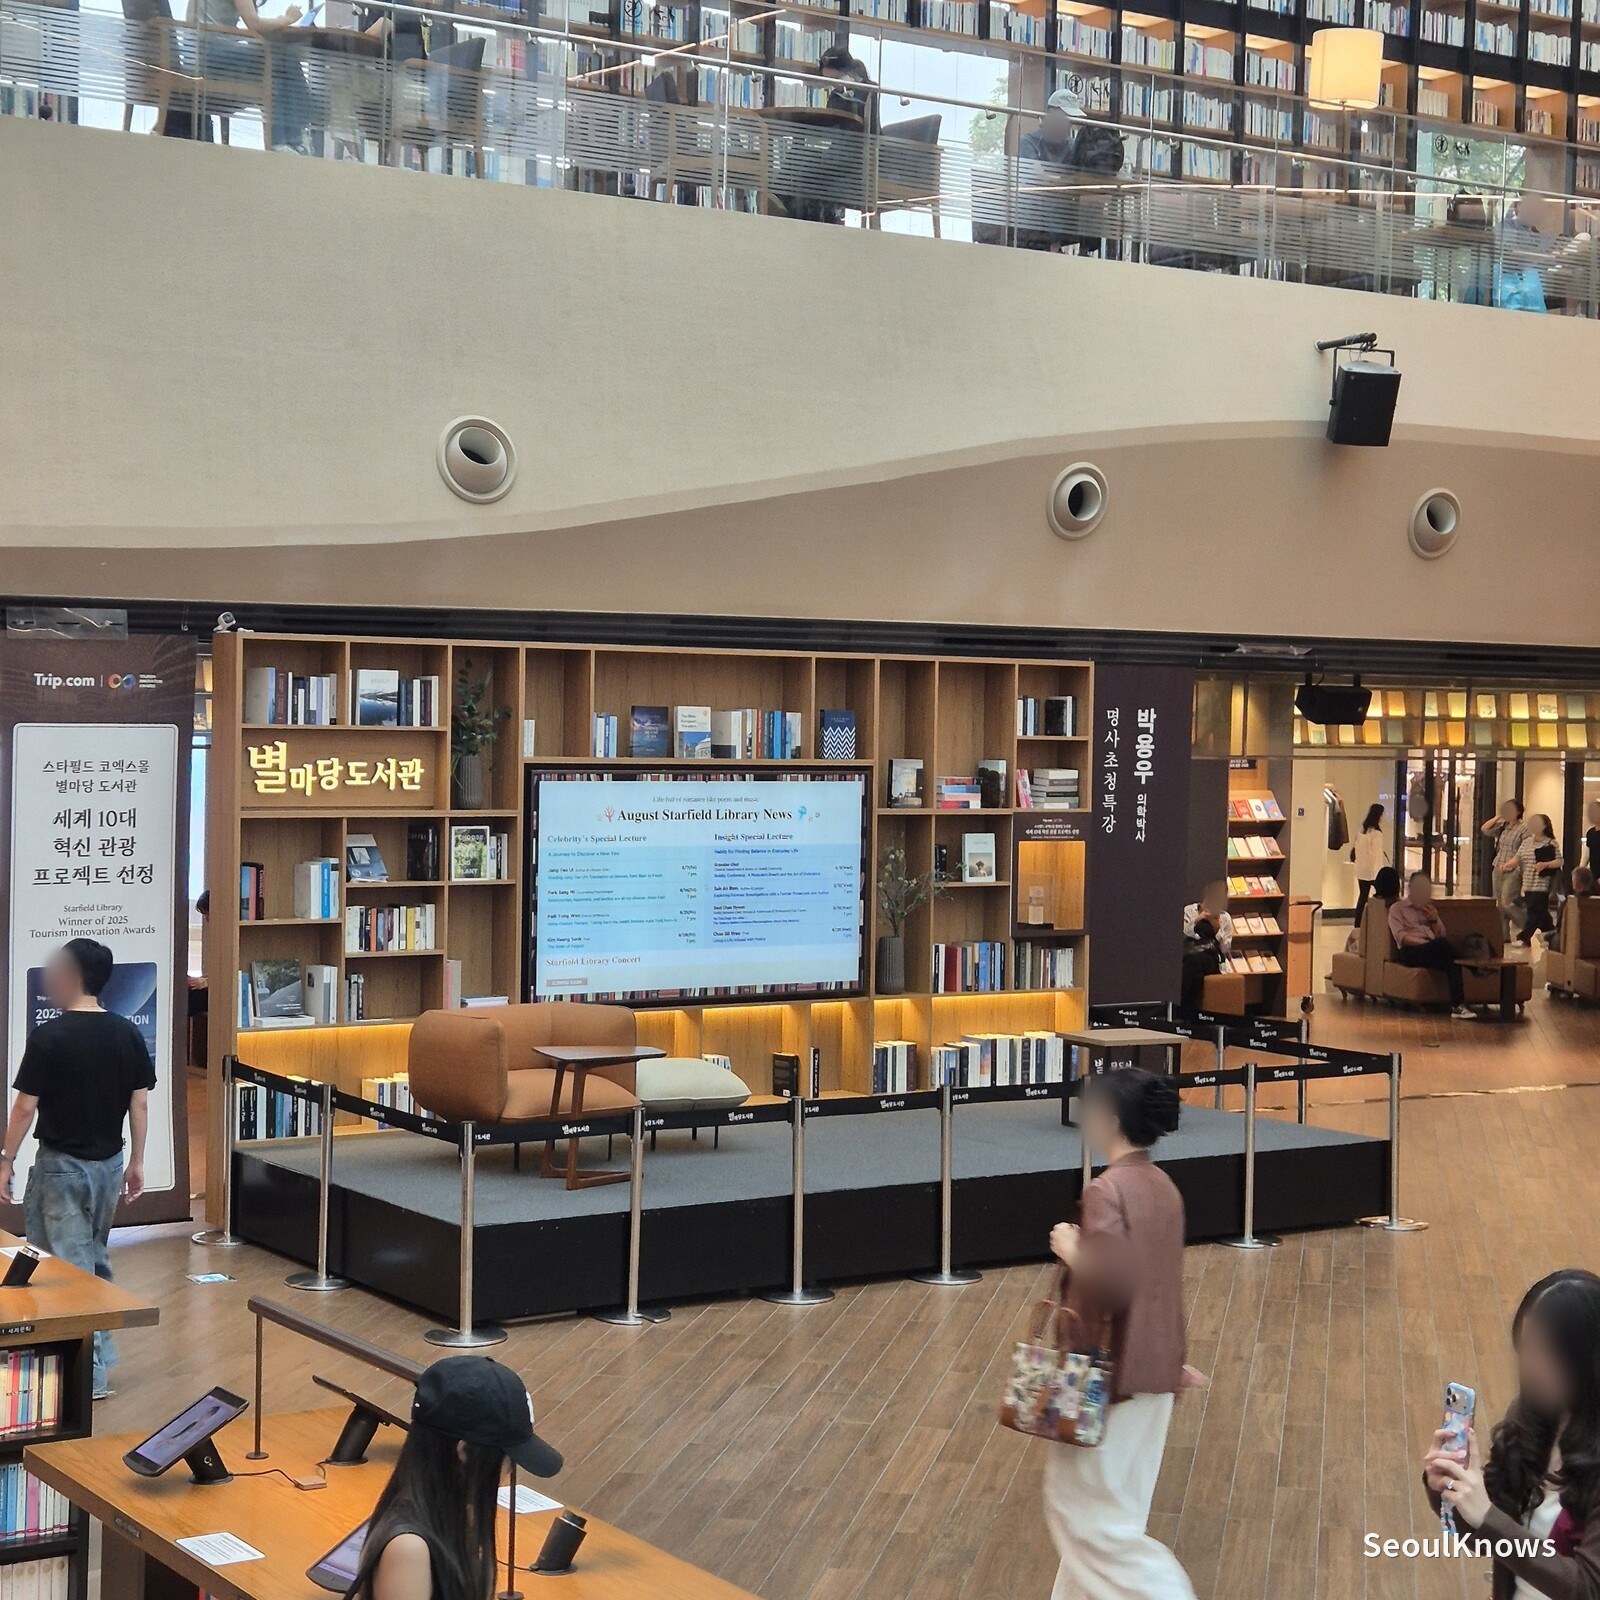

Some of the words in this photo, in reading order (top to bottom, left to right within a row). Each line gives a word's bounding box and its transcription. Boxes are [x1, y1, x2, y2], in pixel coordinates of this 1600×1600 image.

[33, 672, 95, 690] Trip.com
[1133, 707, 1157, 785] 박용우
[42, 759, 96, 774] 스타필드
[99, 759, 150, 774] 코엑스몰
[55, 778, 95, 794] 별마당
[98, 778, 138, 793] 도서관
[52, 808, 92, 829] 세계
[98, 807, 138, 829] 10대
[618, 809, 659, 824] August
[662, 809, 712, 821] Starfield
[715, 809, 760, 823] Library
[763, 808, 793, 820] News
[547, 835, 589, 844] Celebrity's
[590, 834, 617, 844] Special
[619, 834, 647, 842] Lecture
[714, 833, 739, 842] Insight
[740, 833, 765, 842] Special
[53, 837, 92, 858] 혁신
[98, 836, 138, 857] 관광
[32, 866, 111, 886] 프로젝트
[117, 864, 155, 884] 선정
[63, 904, 95, 912] Starfield
[96, 903, 123, 914] Library
[58, 917, 94, 925] Winner
[95, 916, 106, 925] of
[108, 915, 129, 924] 2025
[30, 928, 68, 938] Tourism
[70, 926, 120, 936] Innovation
[122, 924, 155, 935] Awards
[546, 957, 579, 966] Starfield
[581, 957, 609, 966] Library
[612, 956, 641, 964] Concert
